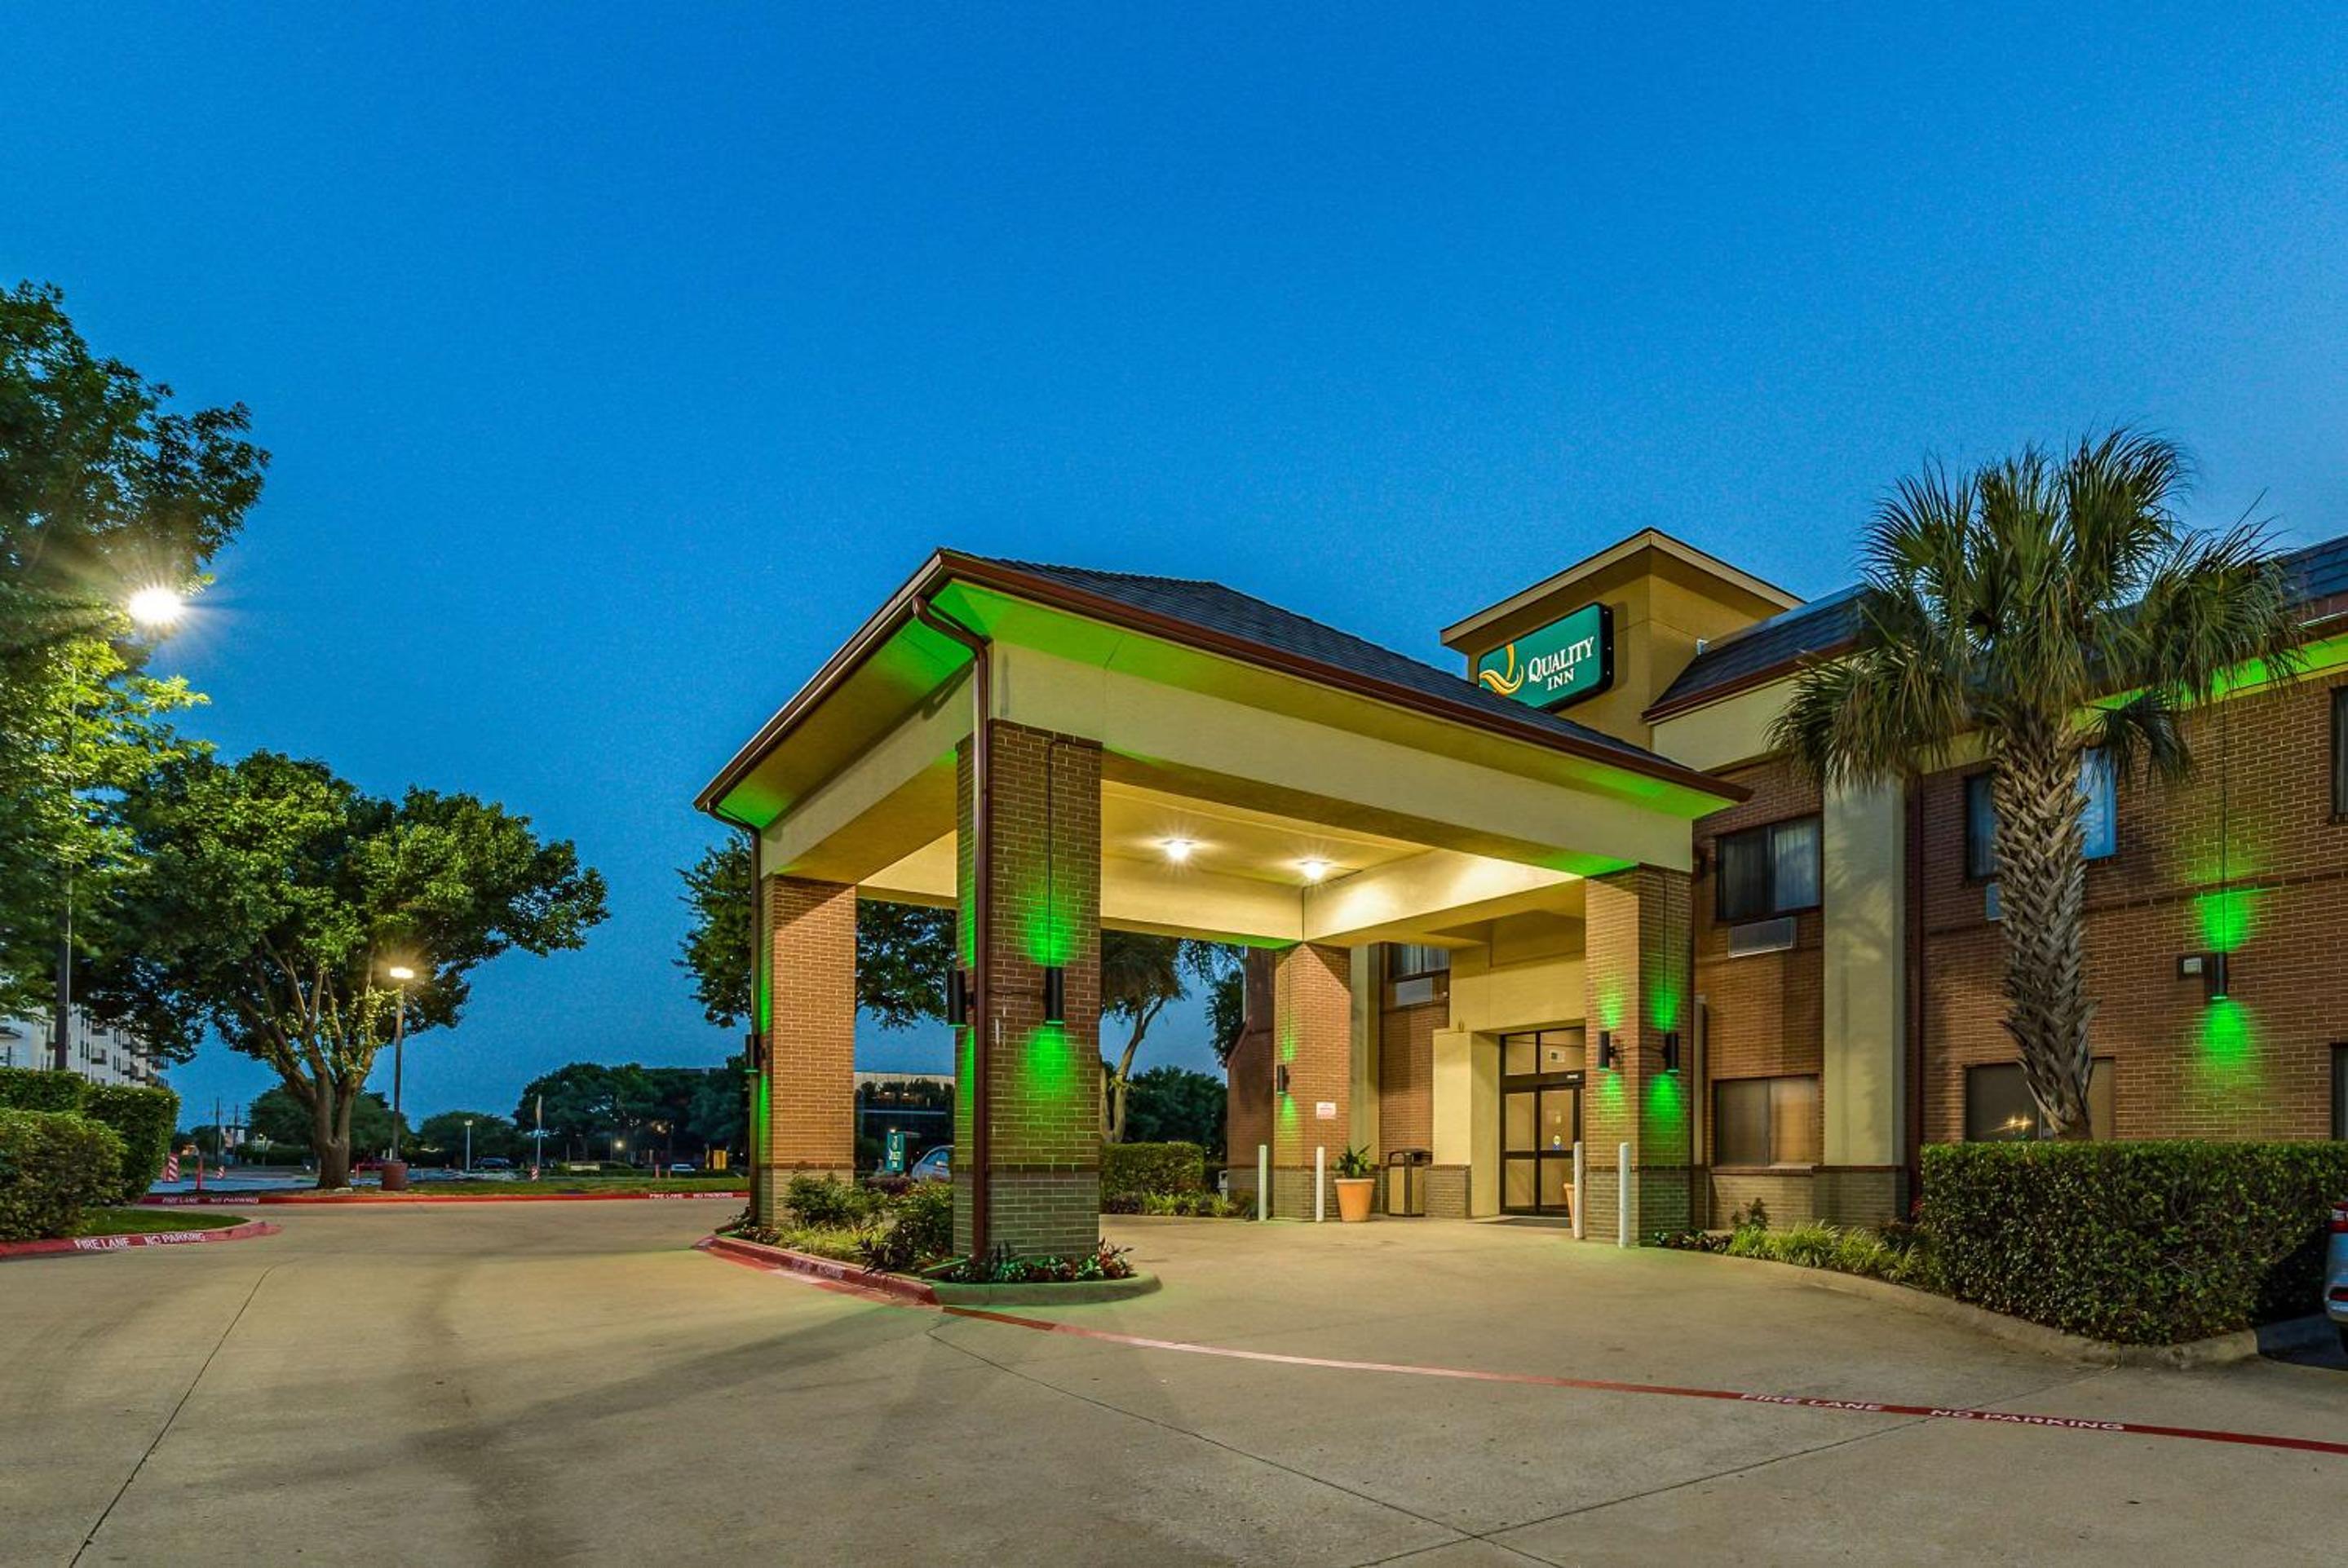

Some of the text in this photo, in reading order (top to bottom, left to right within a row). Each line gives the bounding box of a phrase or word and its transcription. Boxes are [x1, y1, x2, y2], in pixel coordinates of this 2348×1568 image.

[1528, 636, 1594, 682] QUALITY
[1547, 668, 1575, 691] INN
[74, 1239, 101, 1250] FIRE
[1808, 1399, 1882, 1411] LANE
[1930, 1408, 1974, 1417] NO
[1983, 1413, 2125, 1430] PARKING
